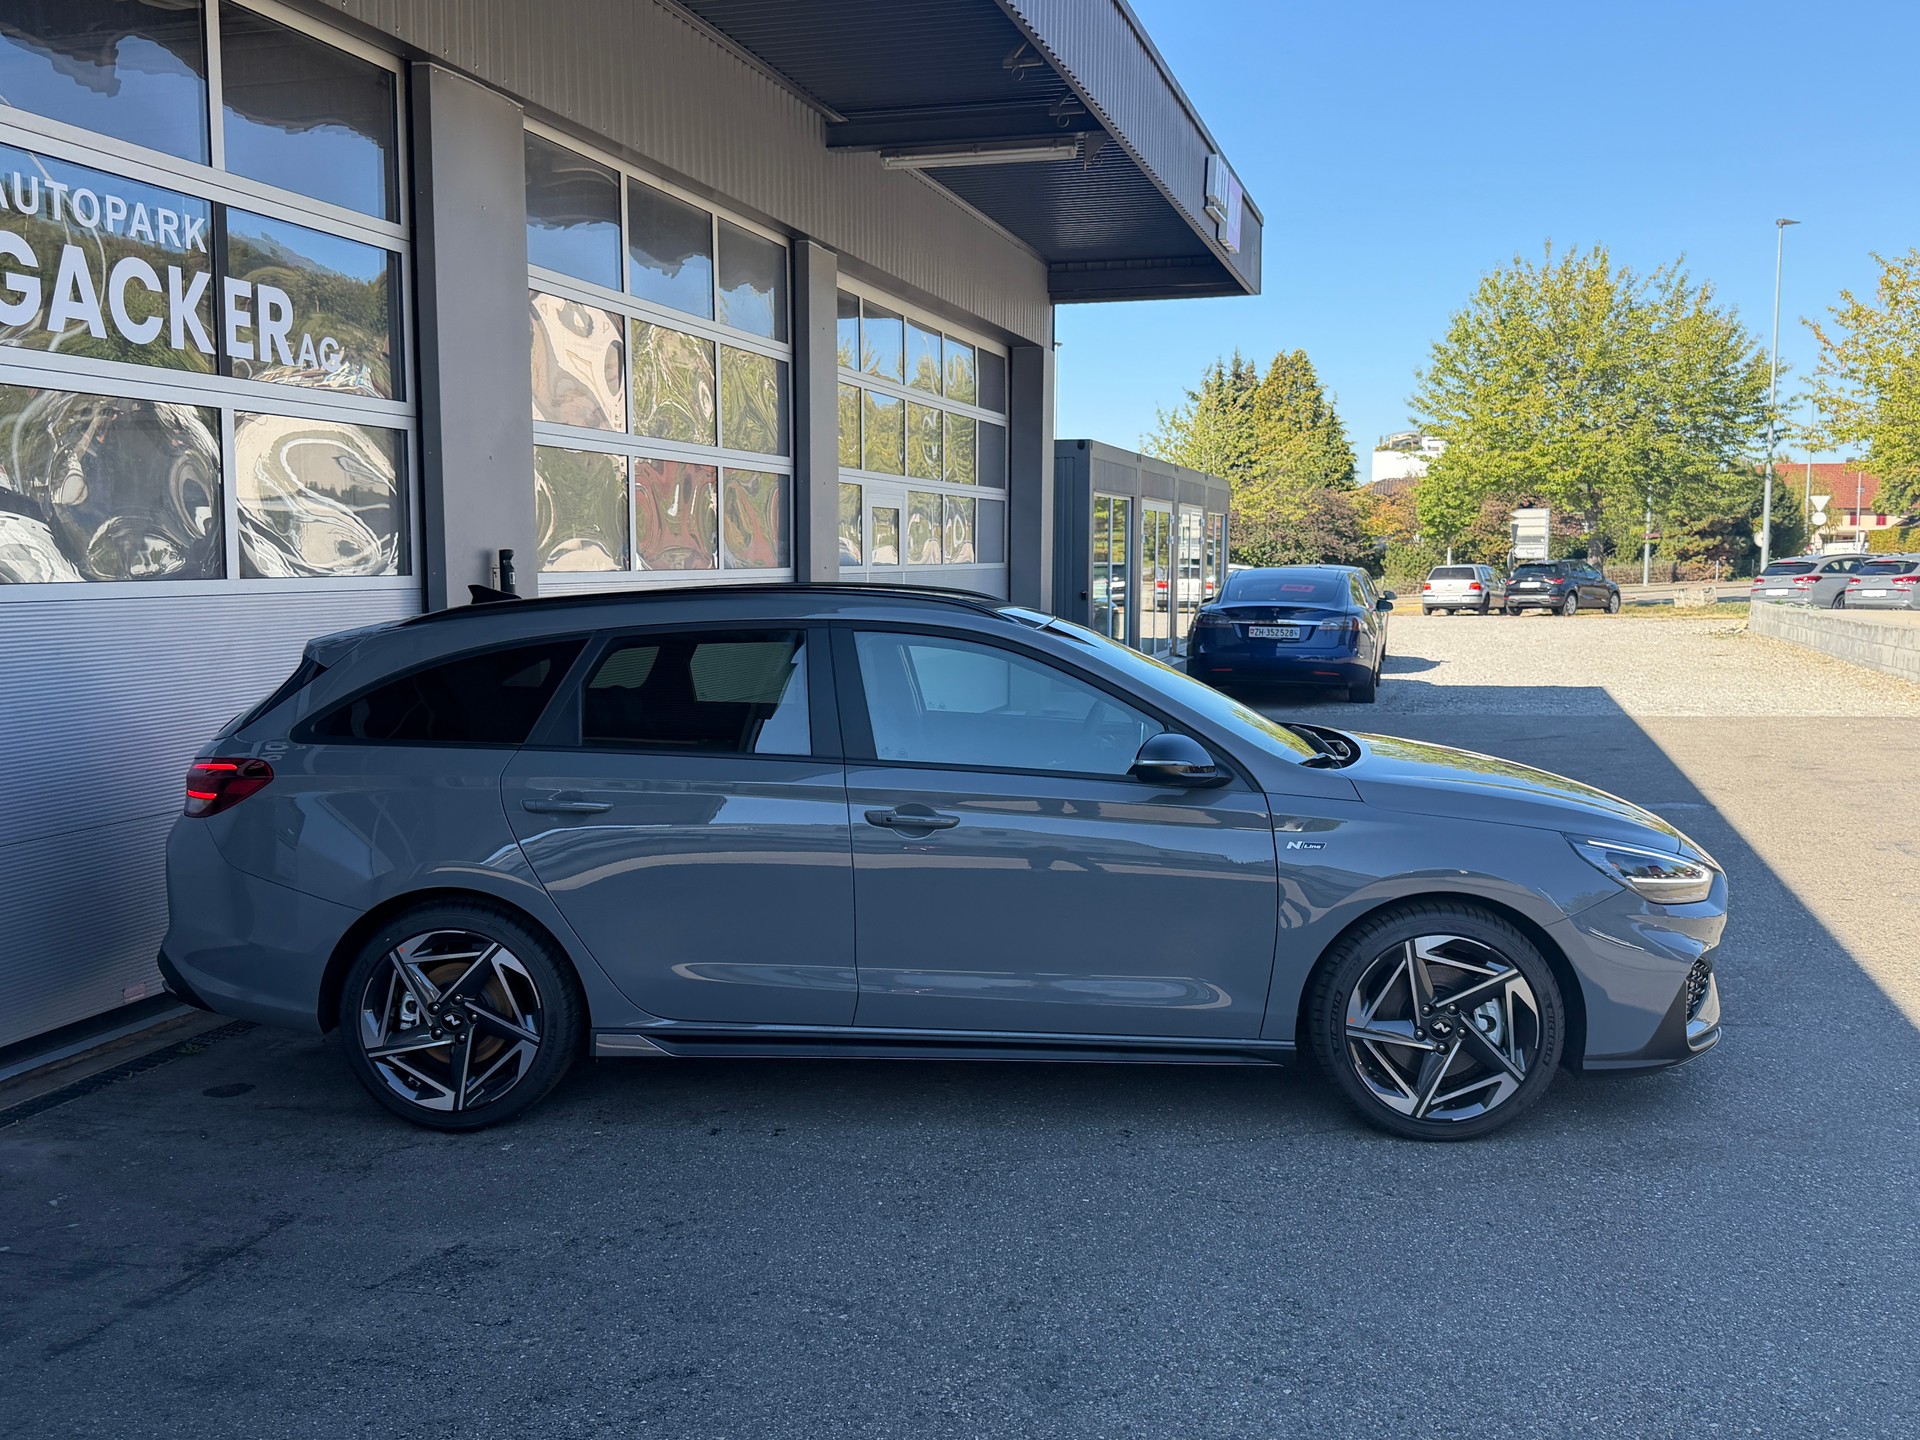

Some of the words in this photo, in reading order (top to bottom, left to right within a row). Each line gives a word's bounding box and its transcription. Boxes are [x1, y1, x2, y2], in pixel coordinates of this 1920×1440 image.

[298, 333, 344, 372] AG
[1286, 840, 1303, 850] N
[1543, 1007, 1556, 1064] MICHELIN
